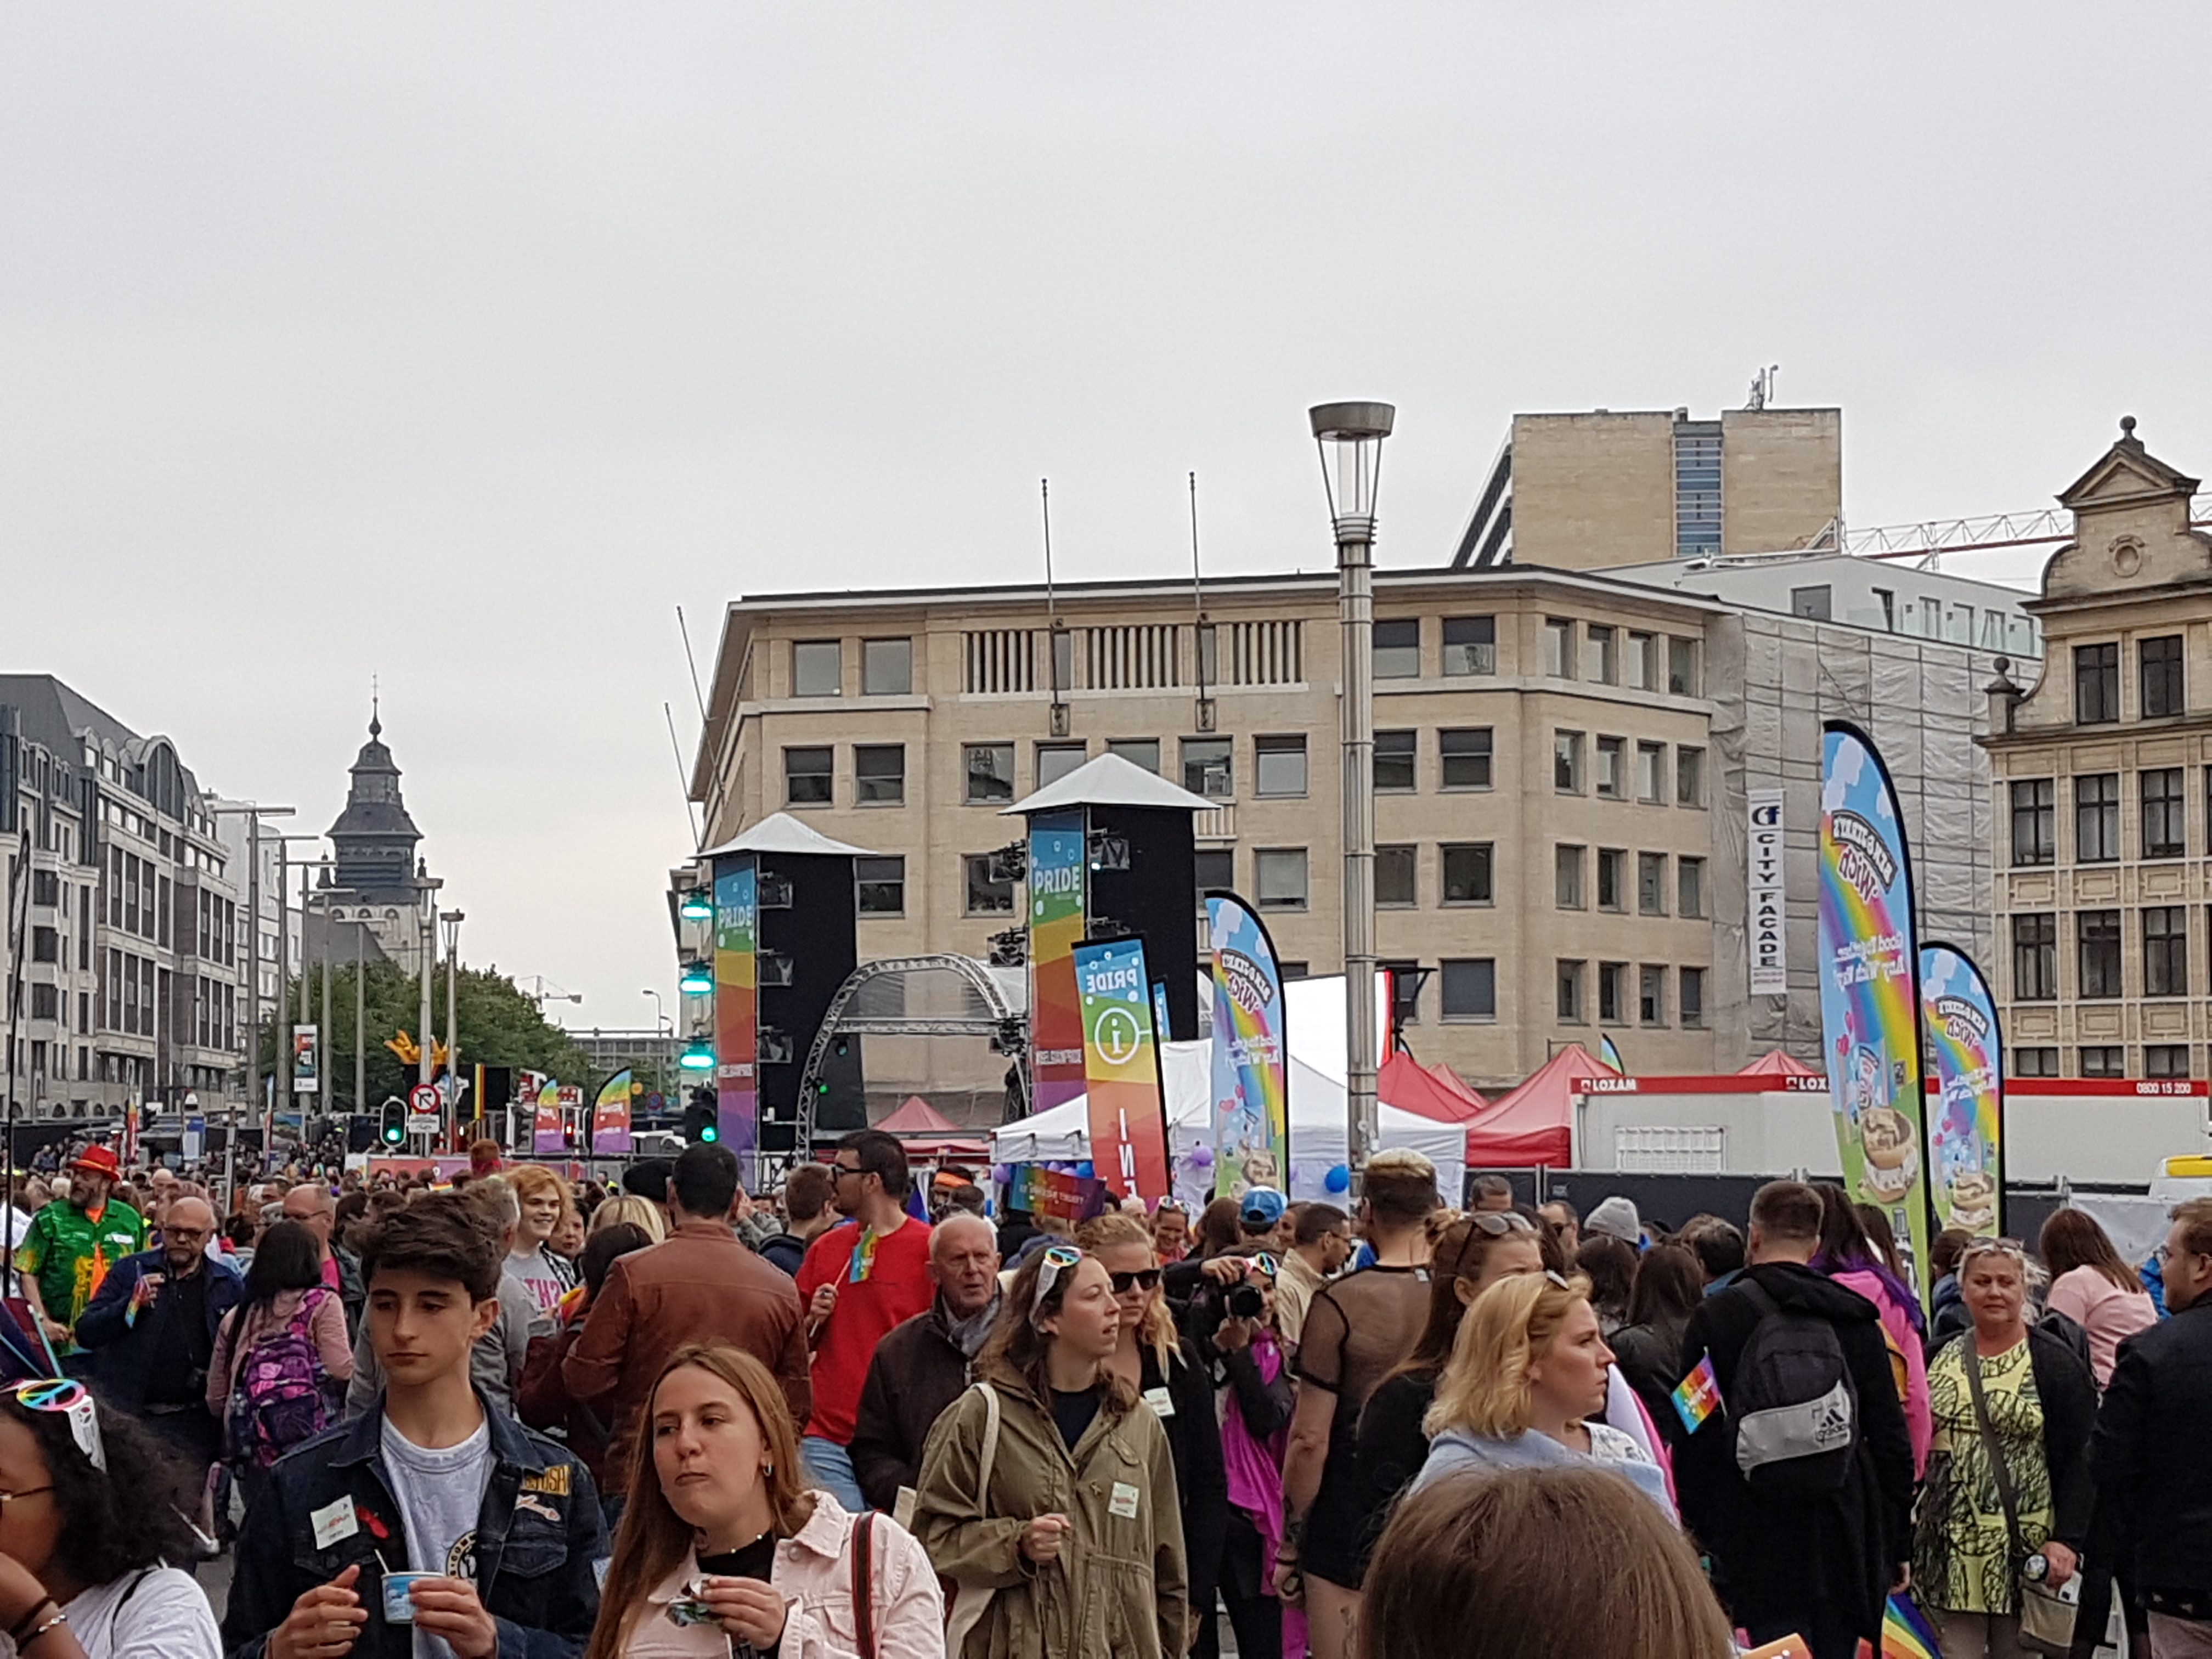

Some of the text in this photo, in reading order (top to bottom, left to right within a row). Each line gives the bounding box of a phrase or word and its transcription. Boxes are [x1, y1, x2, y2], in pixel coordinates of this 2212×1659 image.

[1757, 833, 1776, 884] CITY
[1035, 866, 1080, 896] PRIDE
[718, 906, 752, 929] PRIDE
[1593, 1078, 1637, 1091] LOXAM
[1799, 1077, 1829, 1090] LOX
[2162, 1082, 2172, 1094] 15
